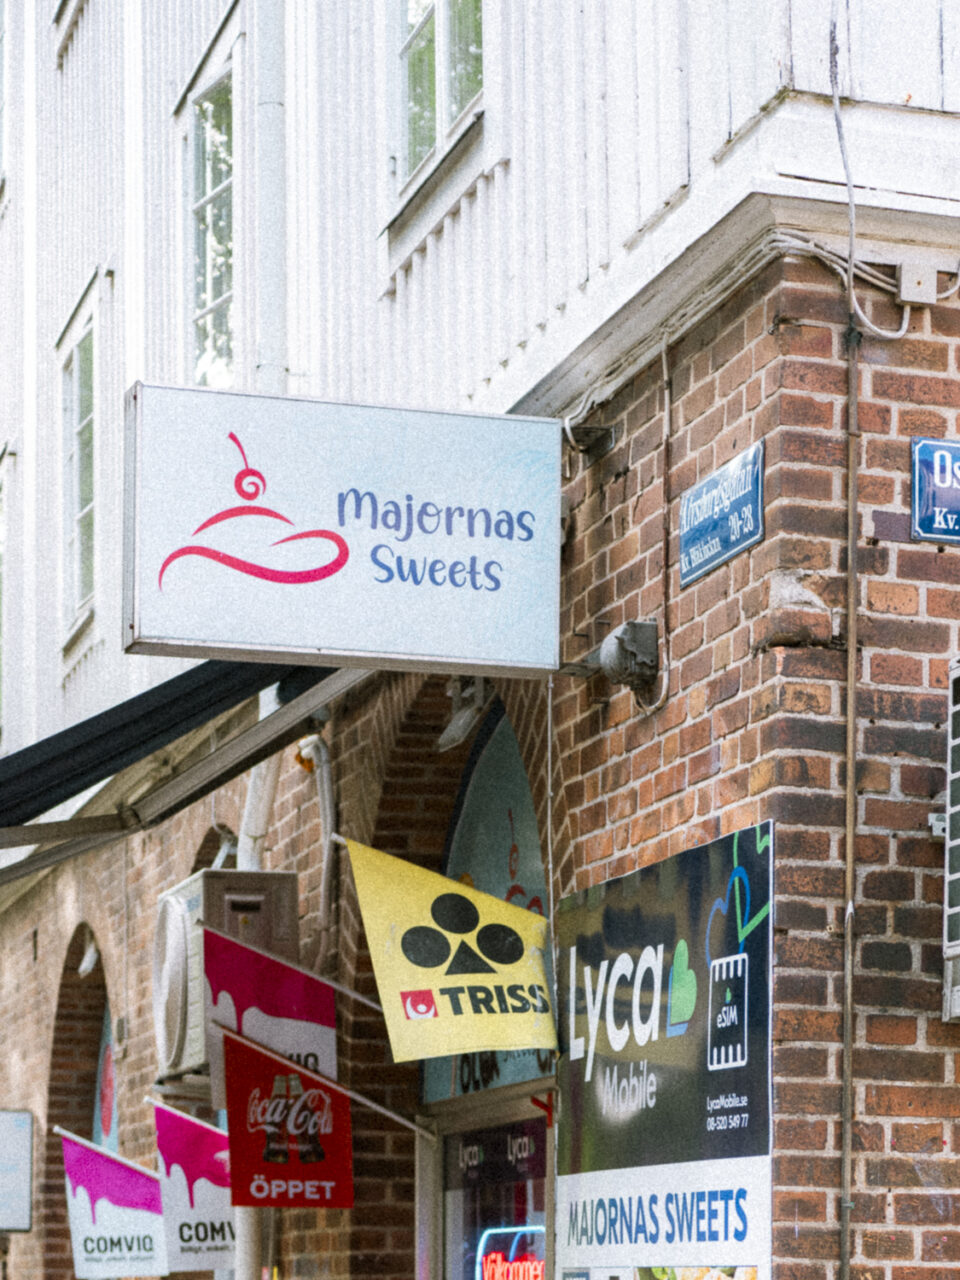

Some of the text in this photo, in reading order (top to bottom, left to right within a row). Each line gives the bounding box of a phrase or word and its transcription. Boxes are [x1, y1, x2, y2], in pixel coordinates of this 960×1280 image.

[337, 486, 536, 542] Majornas
[932, 507, 960, 531] Kv.
[369, 543, 504, 592] Sweets
[439, 984, 550, 1016] TRISS
[569, 942, 666, 1083] Lyca
[716, 1004, 739, 1029] eSIM
[602, 1057, 658, 1117] Mobile
[249, 1173, 336, 1201] ÖPPET
[567, 1187, 749, 1247] MAJORNAS SWEETS
[83, 1233, 155, 1254] COMVIQ
